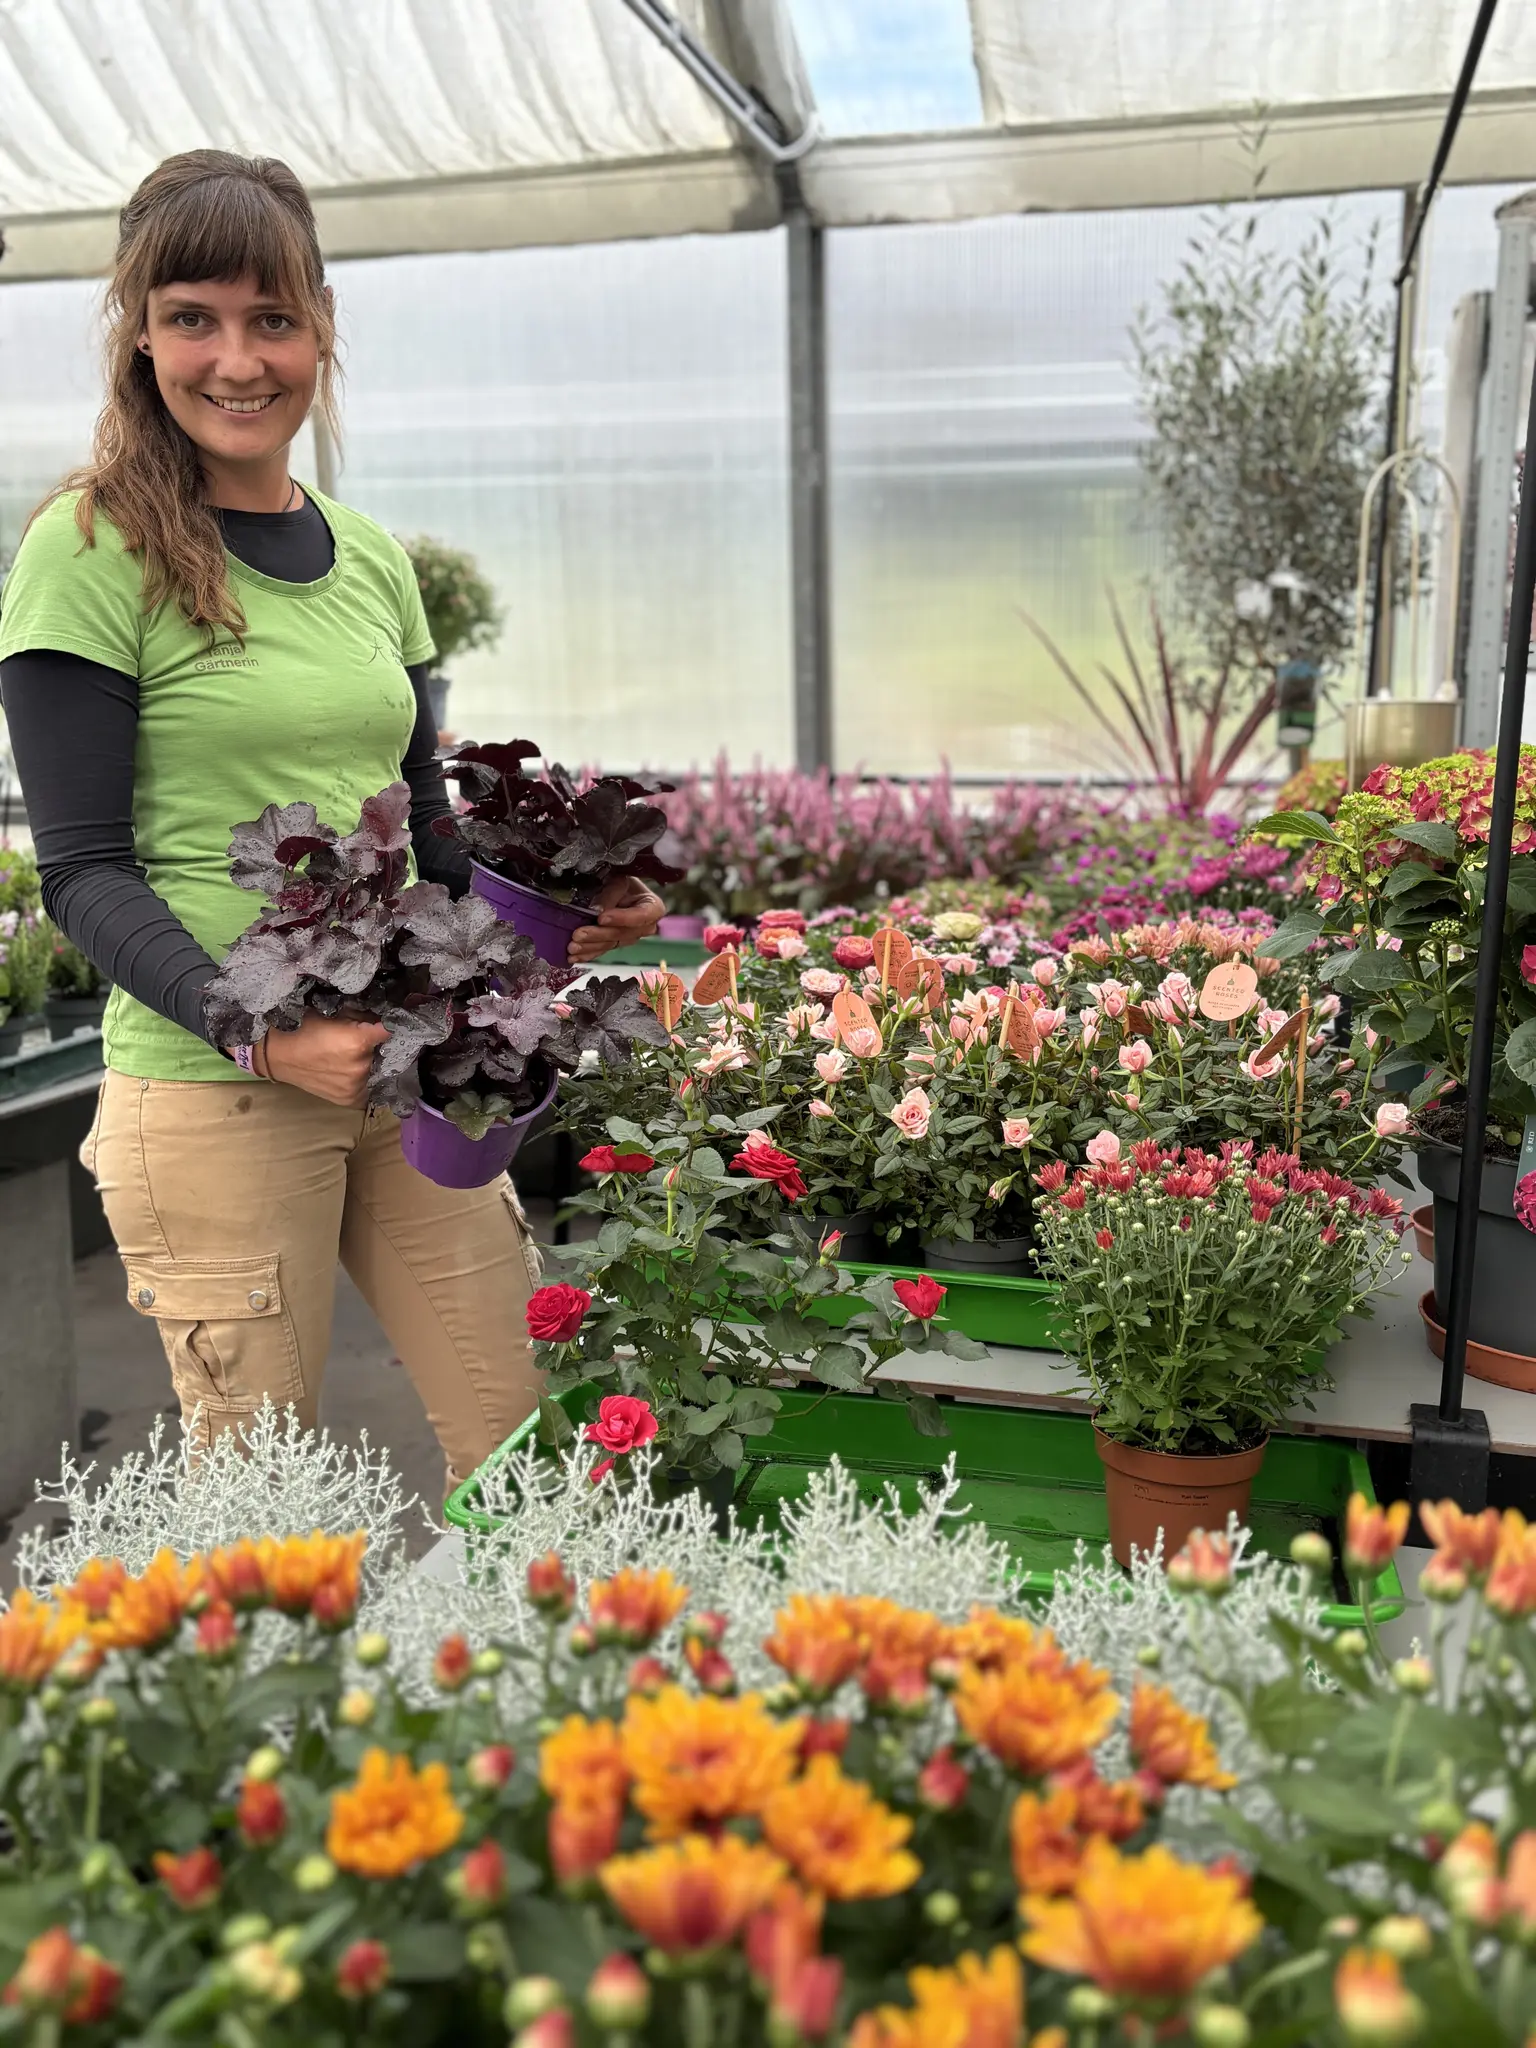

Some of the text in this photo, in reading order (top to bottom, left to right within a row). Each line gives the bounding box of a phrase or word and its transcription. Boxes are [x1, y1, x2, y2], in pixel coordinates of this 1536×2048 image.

[194, 657, 259, 672] Gärtnerin
[1212, 985, 1245, 994] SCENTED
[1215, 991, 1239, 999] ROSES
